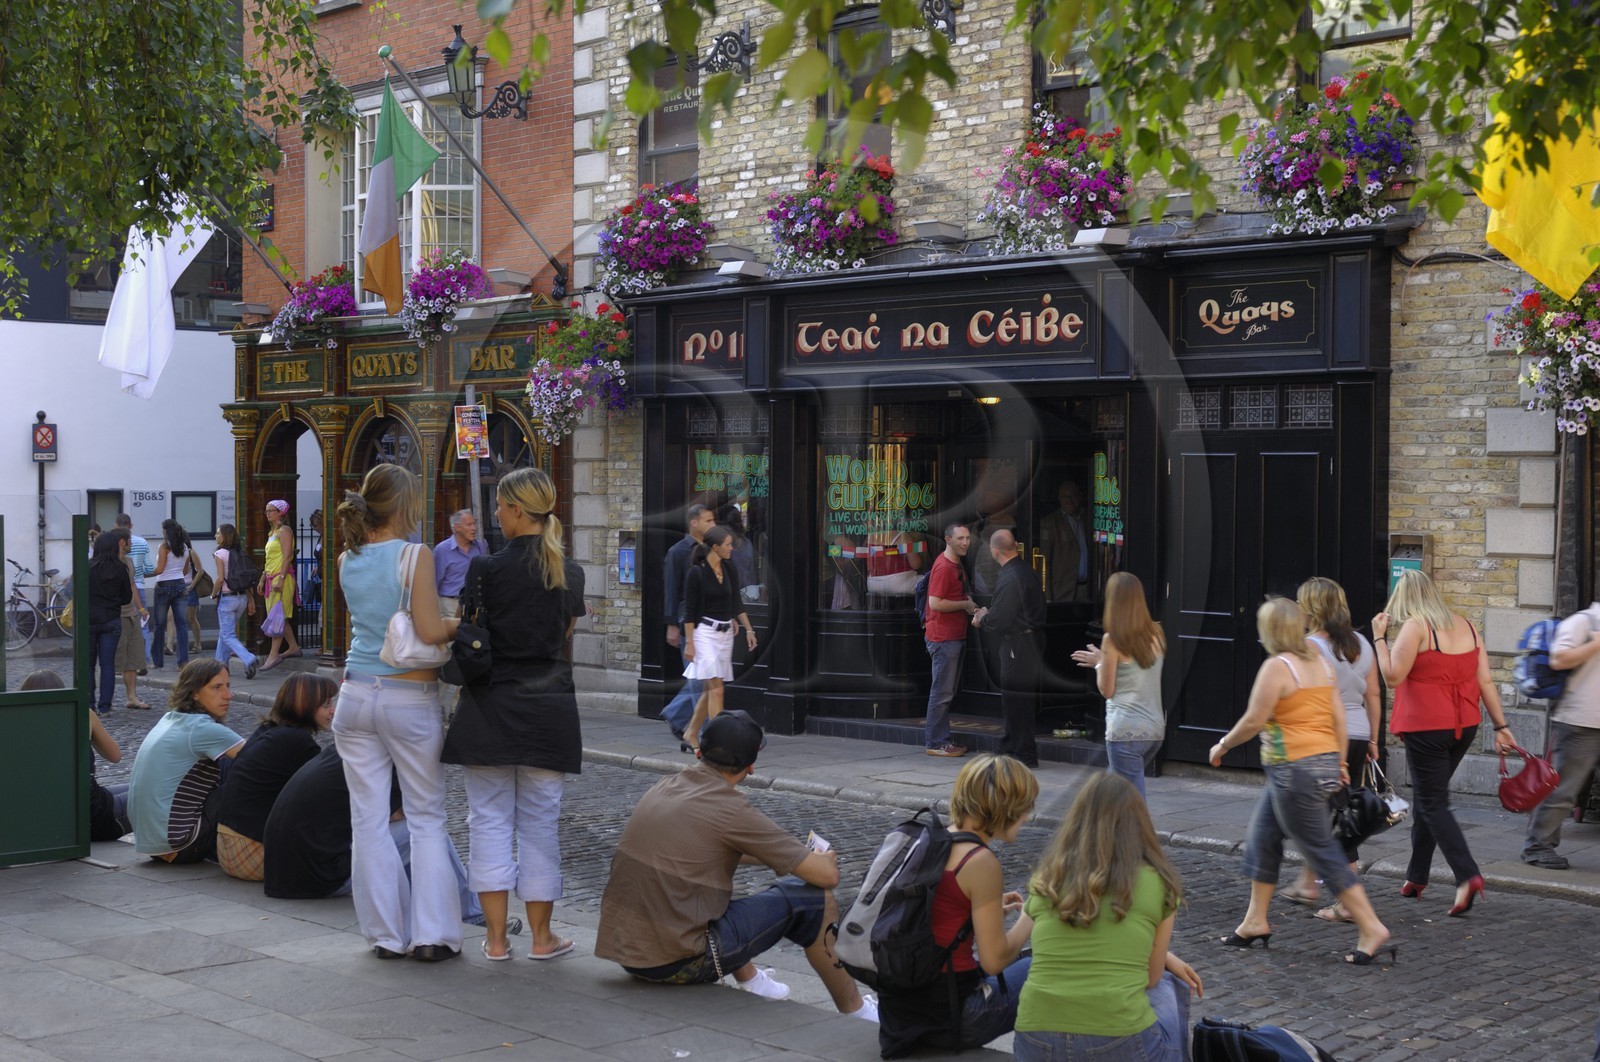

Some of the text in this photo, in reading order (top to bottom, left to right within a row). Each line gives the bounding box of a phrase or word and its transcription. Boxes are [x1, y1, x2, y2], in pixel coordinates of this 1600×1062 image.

[1227, 286, 1249, 307] The
[1199, 298, 1295, 334] Quays
[900, 321, 950, 349] na
[1242, 322, 1269, 340] Bar
[272, 360, 309, 384] THE
[470, 345, 515, 371] BAR
[825, 455, 908, 484] WORLD
[694, 473, 725, 491] 2006
[133, 491, 164, 501] TBG&S
[827, 483, 935, 510] CUP 2006
[829, 511, 851, 523] LIVE
[910, 508, 923, 520] OF
[828, 524, 843, 536] ALL
[896, 519, 929, 534] GAMES
